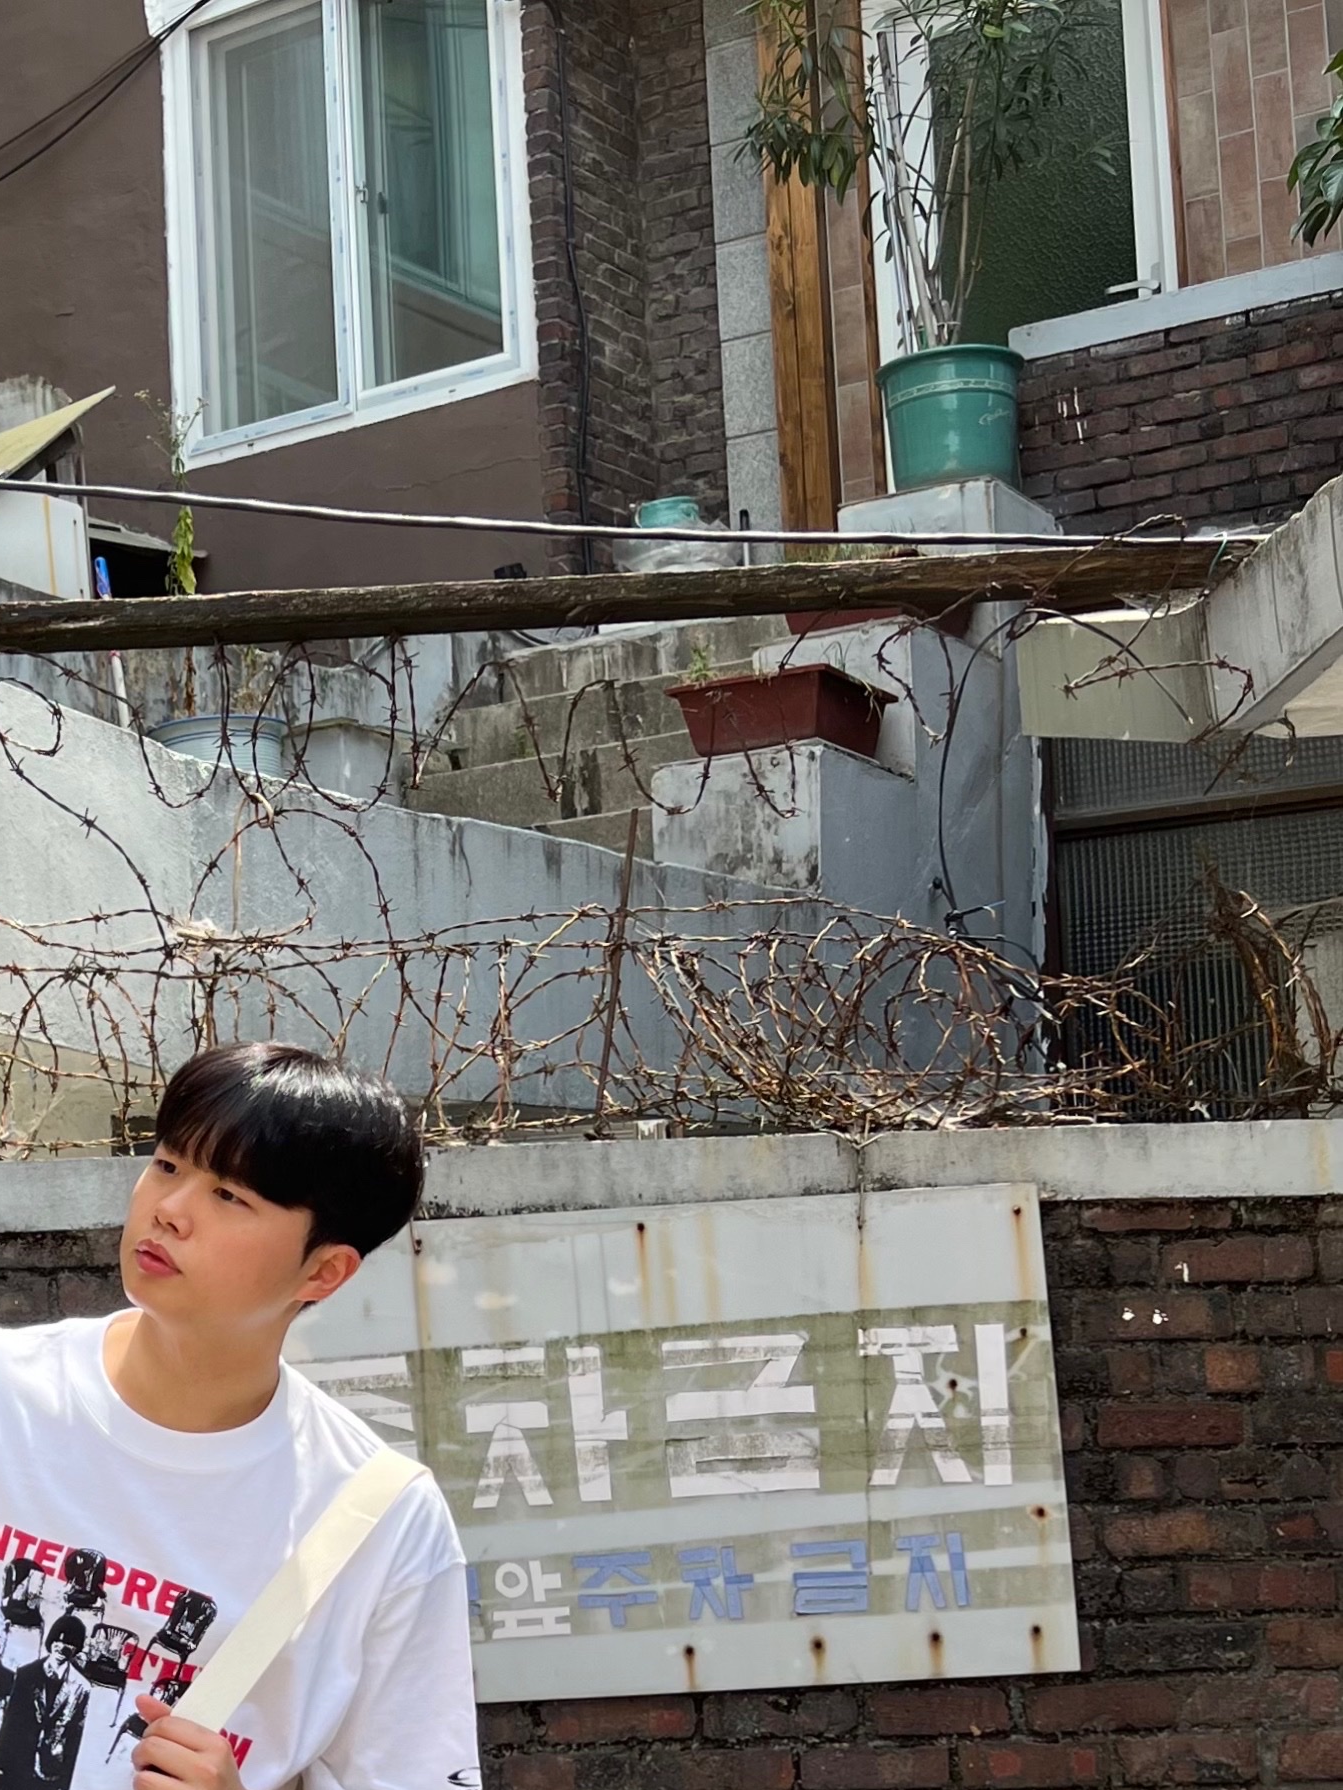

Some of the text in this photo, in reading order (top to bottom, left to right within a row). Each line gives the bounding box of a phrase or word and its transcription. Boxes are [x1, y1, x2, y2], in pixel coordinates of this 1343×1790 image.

[466, 1531, 971, 1641] 앞 주차금지
[122, 1641, 203, 1686] TH
